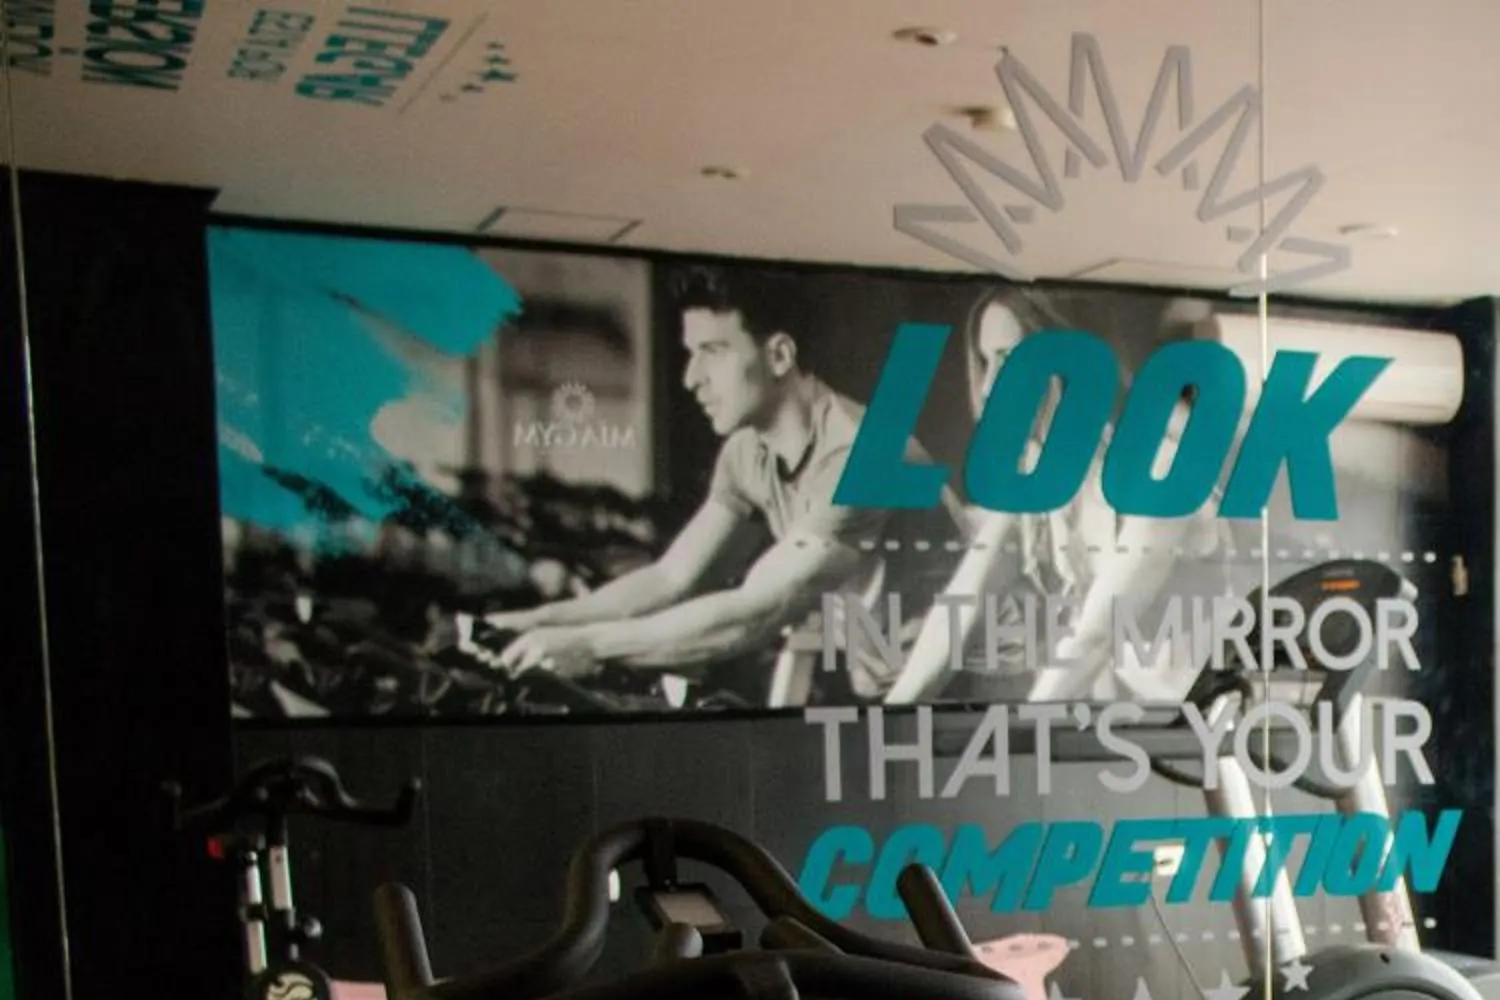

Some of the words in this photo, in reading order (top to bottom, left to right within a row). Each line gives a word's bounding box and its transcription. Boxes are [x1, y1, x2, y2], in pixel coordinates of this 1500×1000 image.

[832, 321, 1394, 521] LOOK
[822, 592, 901, 672] IN
[934, 593, 1081, 670] THE
[1112, 595, 1422, 671] MIRROR
[804, 702, 1152, 801] THAT'S
[1179, 700, 1436, 789] YOUR
[799, 809, 1463, 922] COMPETITION
